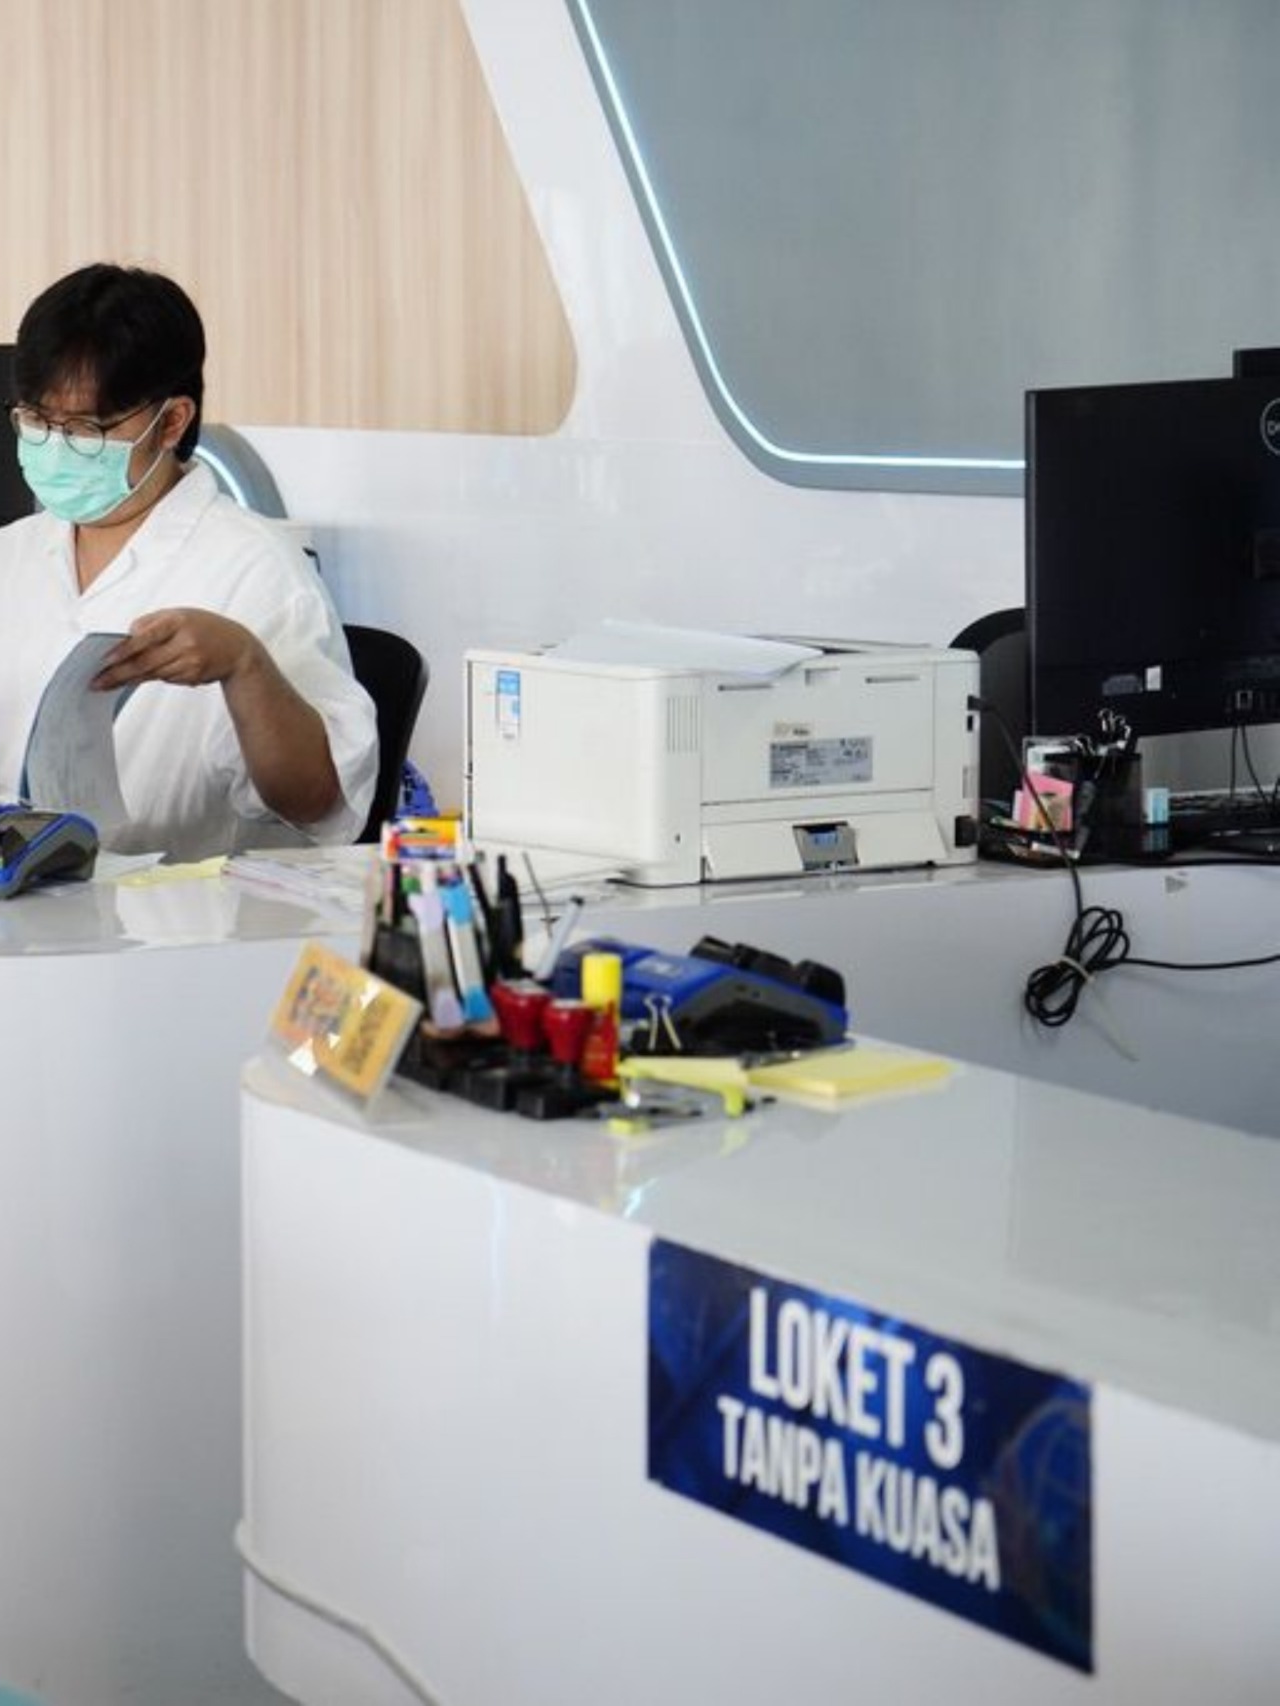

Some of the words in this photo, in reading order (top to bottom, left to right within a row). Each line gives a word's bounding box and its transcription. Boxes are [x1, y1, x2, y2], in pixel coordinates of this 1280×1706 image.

[750, 1286, 916, 1449] LOKET
[924, 1352, 965, 1470] 3
[717, 1395, 849, 1527] TANPA
[854, 1450, 1001, 1592] KUASA
